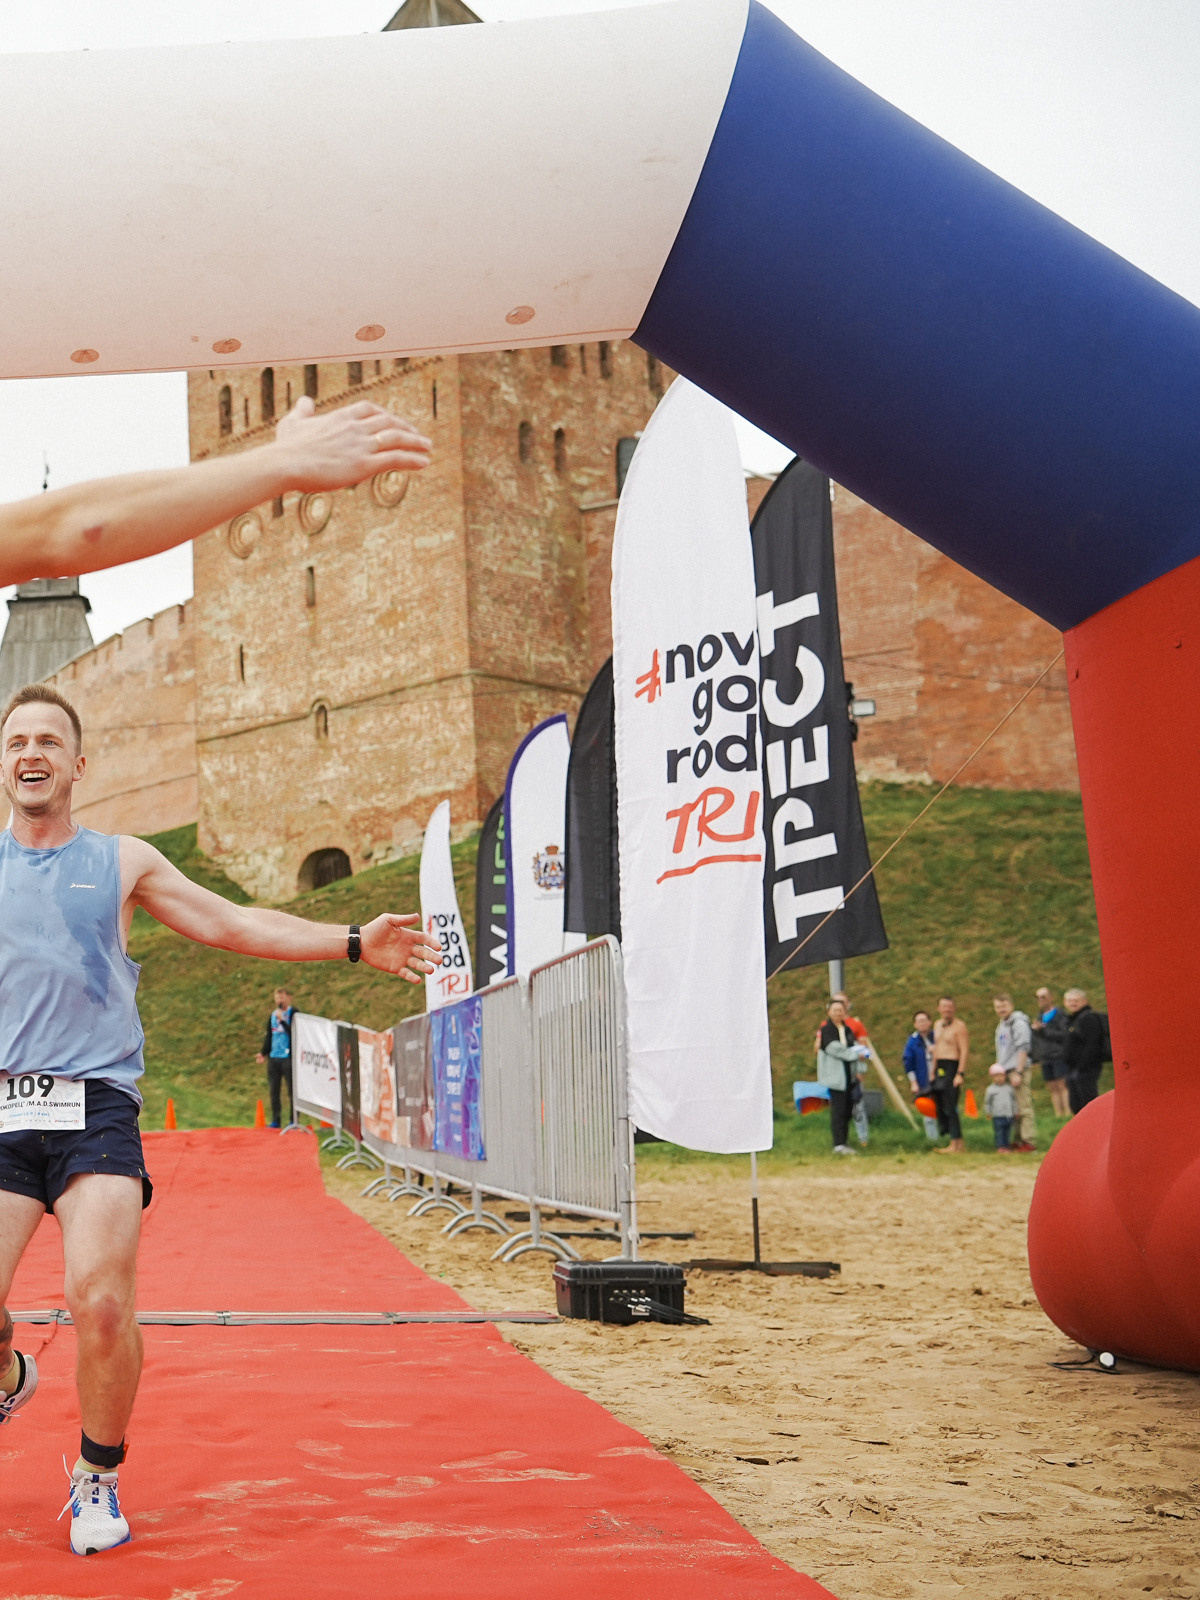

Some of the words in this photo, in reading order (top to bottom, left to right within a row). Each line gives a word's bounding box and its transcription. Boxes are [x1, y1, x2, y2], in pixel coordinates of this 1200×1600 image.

[635, 632, 755, 703] #nov
[692, 675, 757, 735] go
[667, 713, 757, 784] rod
[666, 787, 760, 853] TRI
[438, 946, 466, 969] od
[439, 931, 460, 950] go
[437, 974, 469, 996] TRI
[6, 1074, 54, 1101] 109
